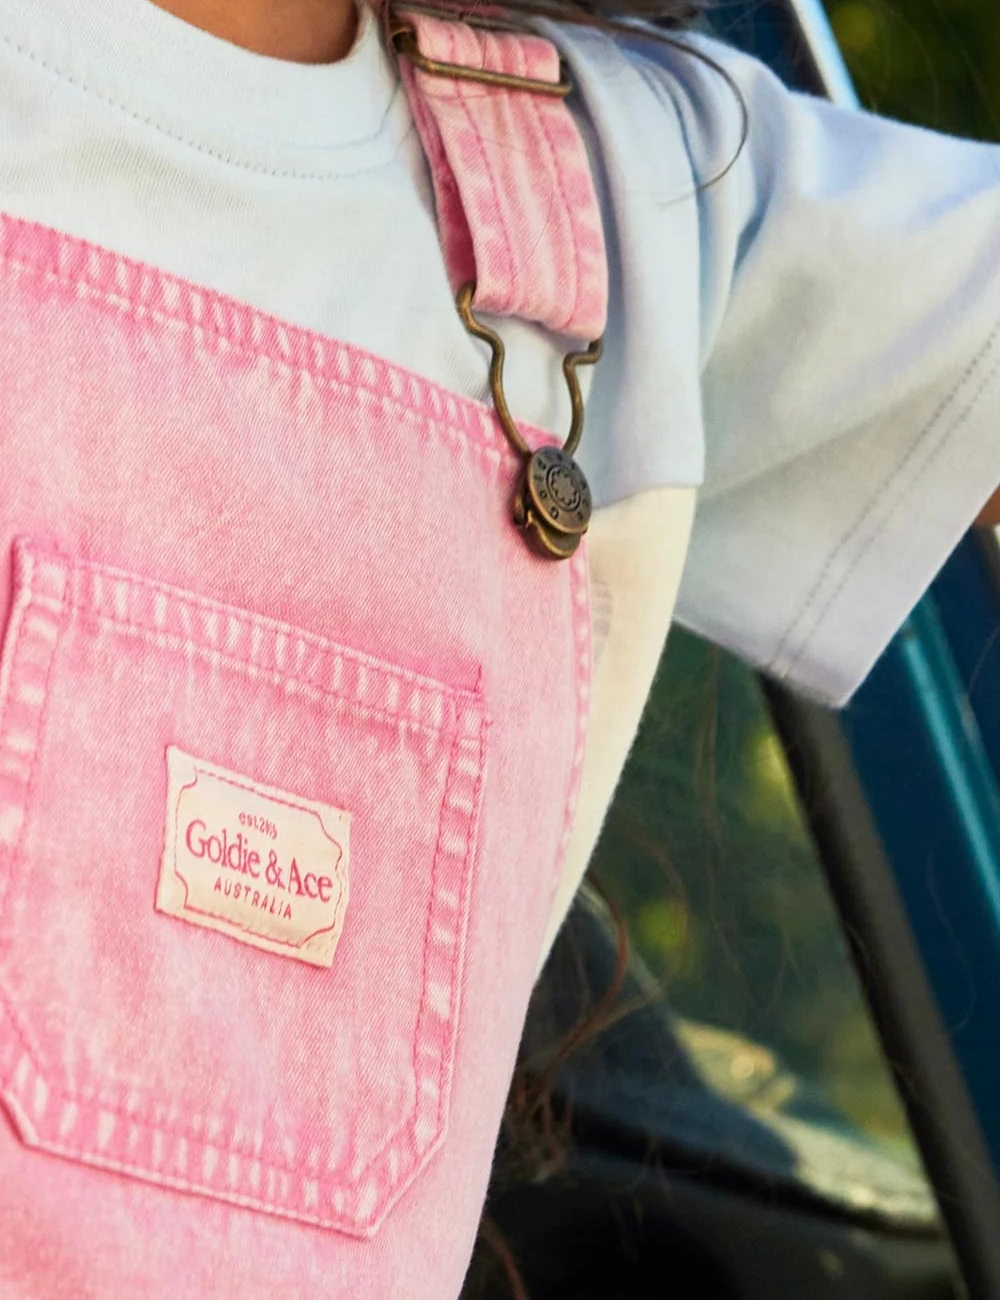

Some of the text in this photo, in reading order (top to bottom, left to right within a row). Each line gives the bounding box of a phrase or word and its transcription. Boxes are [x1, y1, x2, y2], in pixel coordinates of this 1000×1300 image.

[185, 818, 261, 878] Goldie
[265, 848, 286, 890] &
[288, 857, 333, 903] Ace
[214, 876, 292, 920] AUSTRALIA
